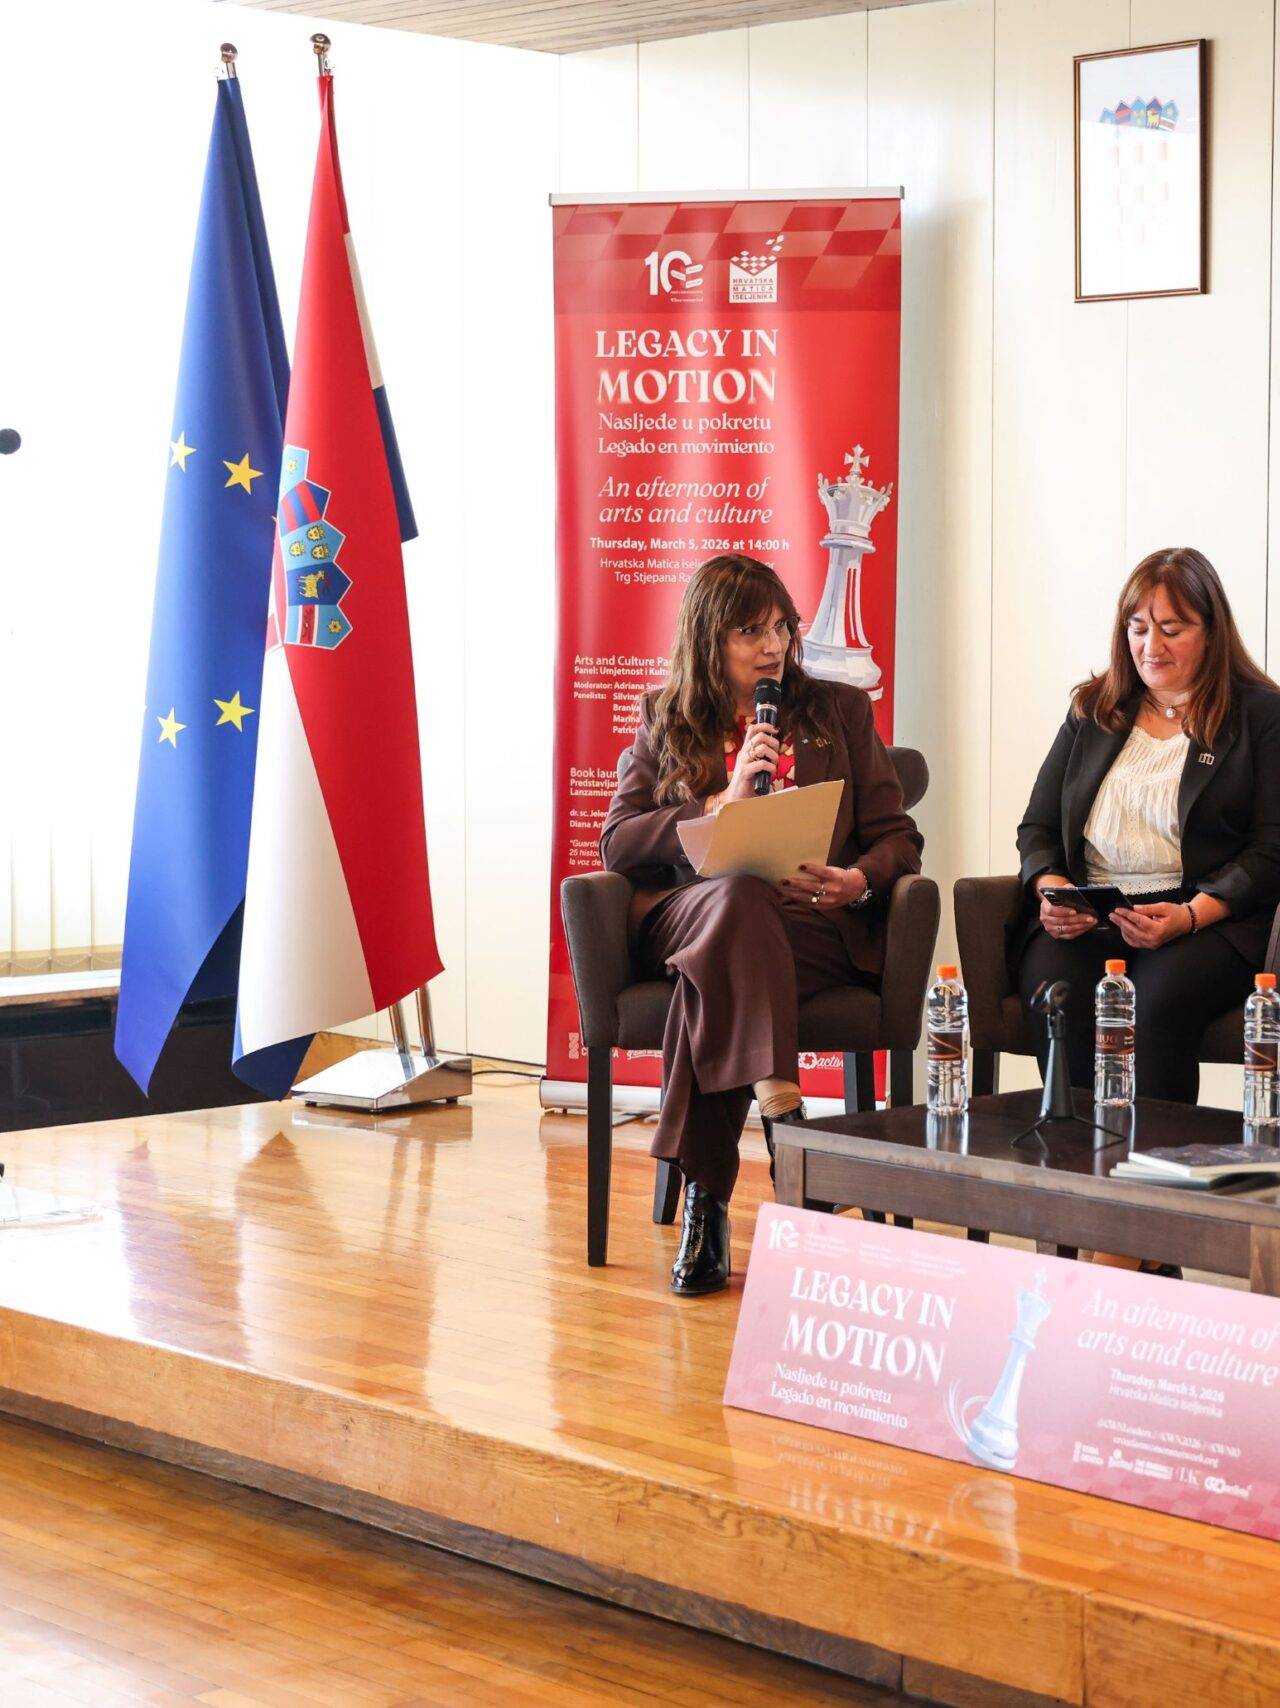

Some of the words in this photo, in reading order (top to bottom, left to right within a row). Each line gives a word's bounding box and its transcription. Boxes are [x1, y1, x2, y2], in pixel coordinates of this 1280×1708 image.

[593, 329, 732, 358] LEGACY
[740, 329, 779, 357] IN
[596, 368, 777, 404] MOTION
[681, 417, 693, 430] u
[697, 412, 772, 434] pokretu
[598, 437, 656, 458] Legado
[658, 442, 678, 454] en
[681, 438, 776, 454] movimiento
[598, 476, 630, 498] An
[635, 476, 741, 500] afternoon
[746, 476, 772, 501] of
[599, 504, 643, 523] arts
[648, 502, 693, 524] and
[695, 502, 773, 524] culture
[590, 537, 648, 552] Thursday,
[650, 538, 686, 550] March
[688, 539, 699, 552] 5,
[701, 539, 730, 550] 2026
[732, 540, 745, 550] at
[748, 539, 780, 551] 14:00
[782, 540, 790, 550] h
[599, 558, 645, 569] Hrvatska
[646, 559, 680, 569] Matica
[614, 572, 631, 584] Trg
[633, 572, 677, 585] Stjepana
[574, 655, 594, 665] Arts
[596, 656, 615, 666] and
[617, 656, 655, 667] Culture
[574, 666, 599, 674] Panel:
[599, 667, 643, 676] Umjetnost
[573, 681, 613, 690] Moderator:
[614, 682, 645, 690] Adriana
[573, 691, 607, 700] Panelists:
[570, 767, 595, 778] Book
[569, 820, 591, 828] Diana
[789, 1265, 914, 1321] LEGACY
[916, 1290, 957, 1330] IN
[1081, 1289, 1121, 1320] An
[1122, 1297, 1247, 1345] afternoon
[782, 1311, 947, 1385] MOTION
[1076, 1326, 1128, 1356] arts
[1130, 1338, 1186, 1367] and
[1184, 1347, 1280, 1387] culture
[829, 1379, 839, 1391] u
[839, 1382, 893, 1404] pokretu
[1108, 1383, 1148, 1402] Hrvatska
[1110, 1368, 1157, 1389] Thursday,
[1157, 1378, 1188, 1395] March
[1199, 1386, 1225, 1404] 2026
[769, 1381, 815, 1406] Legado
[816, 1395, 833, 1410] en
[834, 1400, 909, 1429] movimiento
